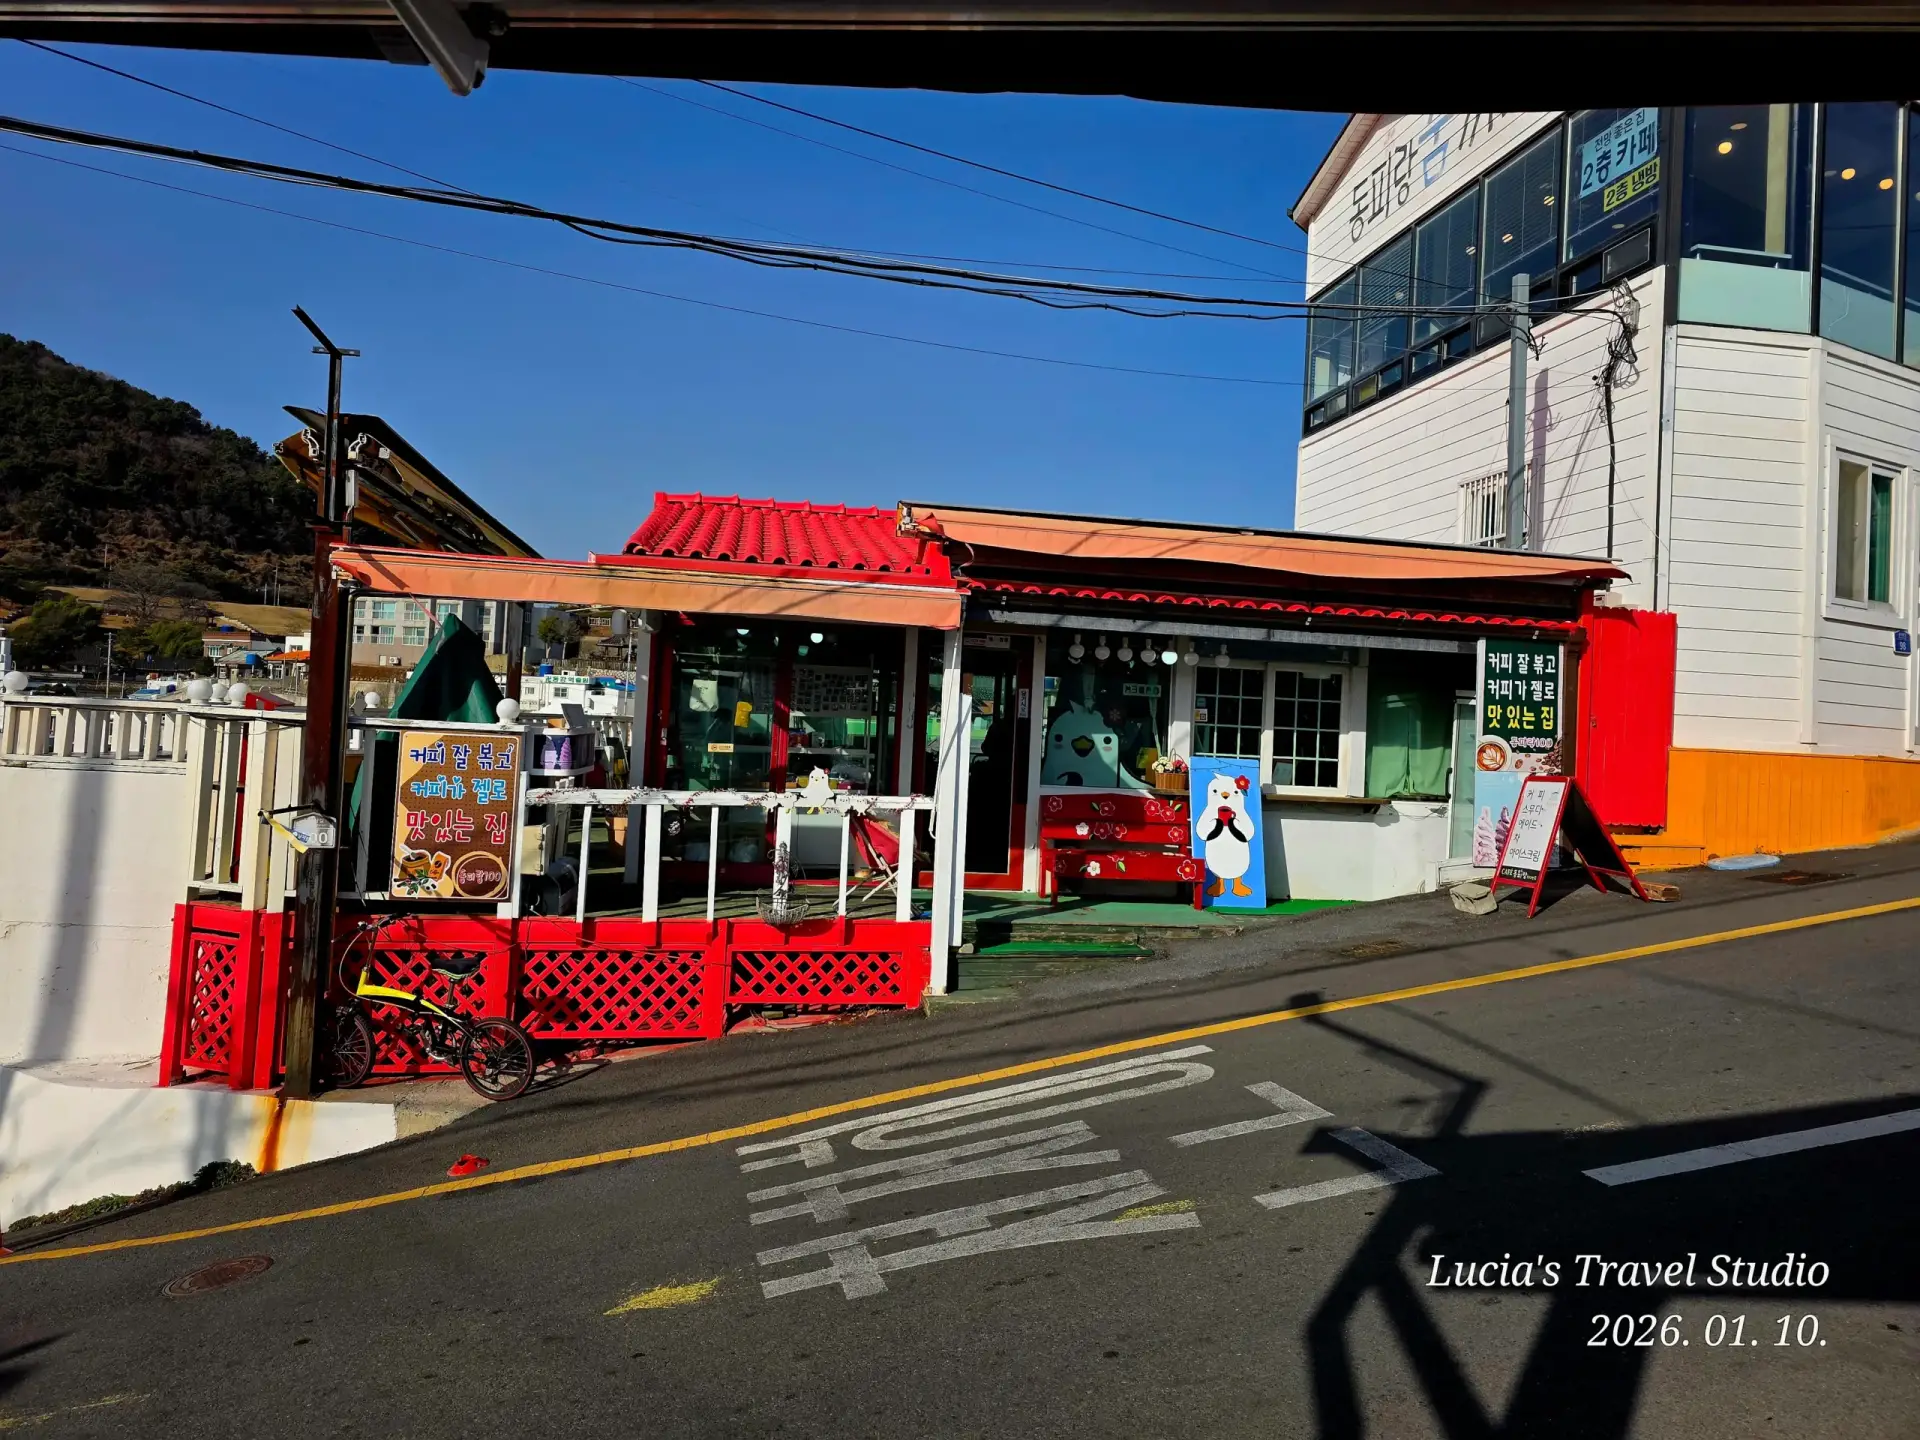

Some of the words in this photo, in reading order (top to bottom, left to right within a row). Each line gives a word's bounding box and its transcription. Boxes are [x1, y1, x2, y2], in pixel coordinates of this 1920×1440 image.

[1594, 132, 1612, 152] 전망
[1614, 117, 1634, 139] 좋은
[1636, 109, 1645, 126] 집
[1582, 148, 1612, 191] 2층
[1616, 121, 1656, 167] 카페
[1349, 139, 1418, 243] 동피랑
[1605, 180, 1629, 208] 2층
[1632, 161, 1658, 192] 냉방
[1488, 652, 1513, 674] 커피
[1517, 653, 1530, 674] 잘
[1533, 654, 1556, 674] 볶고
[1487, 679, 1527, 701] 커피가
[1530, 680, 1555, 701] 젤로
[1540, 706, 1554, 730] 집
[409, 741, 446, 765] 커피
[452, 744, 471, 770] 잘
[477, 743, 513, 771] 볶고
[410, 775, 466, 800] 커피가
[471, 777, 508, 805] 젤로
[406, 809, 474, 843] 맛있는
[484, 812, 508, 844] 집
[1509, 848, 1541, 863] 아이스크림
